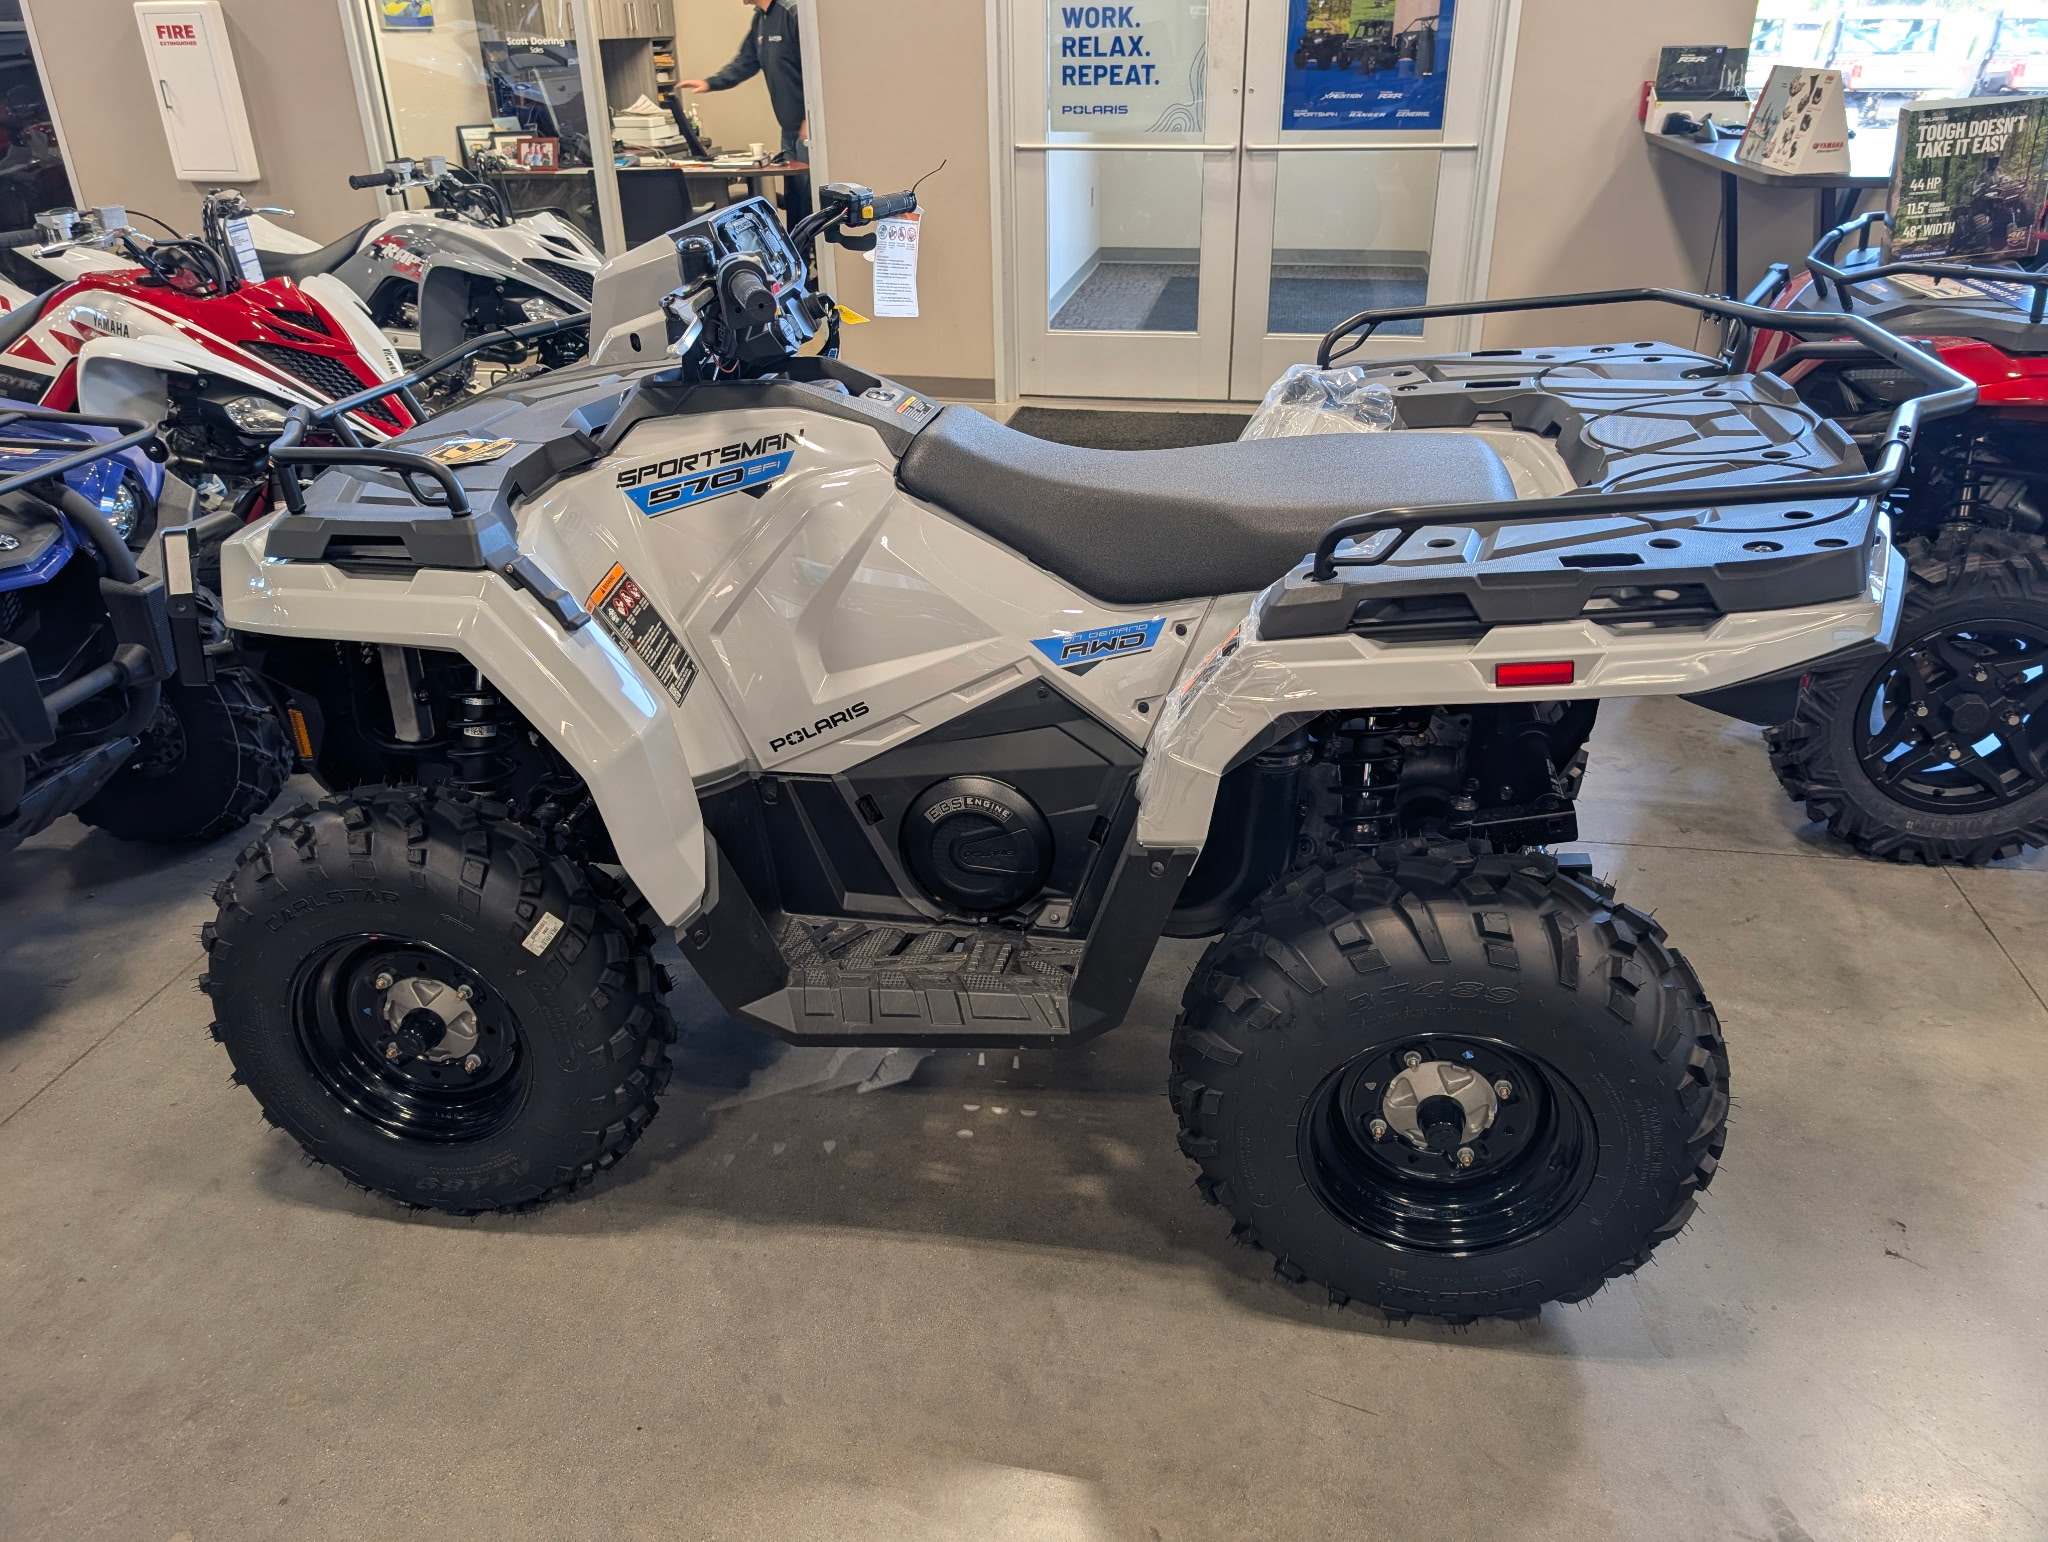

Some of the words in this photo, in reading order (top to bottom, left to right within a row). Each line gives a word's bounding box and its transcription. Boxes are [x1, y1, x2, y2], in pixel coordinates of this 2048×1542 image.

[1061, 6, 1141, 29] WORK.
[156, 25, 196, 39] FIRE
[506, 37, 529, 46] Scott
[530, 37, 566, 48] Doering
[1062, 35, 1151, 57] RELAX.
[1062, 64, 1160, 86] REPEAT.
[1320, 91, 1364, 101] XPEDITION
[1062, 105, 1129, 115] POLARIS
[1395, 110, 1431, 118] GENERAL
[1918, 115, 1949, 123] POLARIS
[1918, 121, 1967, 143] TOUGH
[1968, 115, 2028, 138] DOESN'T
[1915, 140, 1952, 160] TAKE
[1955, 138, 1971, 156] IT
[1972, 134, 2009, 155] EASY
[1910, 178, 1925, 191] 44
[1926, 176, 1942, 190] HP
[1923, 221, 1956, 237] WIDTH
[93, 313, 130, 338] YAMAHA
[616, 429, 805, 488] SPORTSMAN
[647, 466, 745, 508] 570
[748, 460, 781, 476] EFI
[1060, 632, 1147, 660] AWD
[769, 701, 870, 752] POLARIS
[928, 797, 963, 821] EBS
[966, 797, 1011, 818] ENGINE
